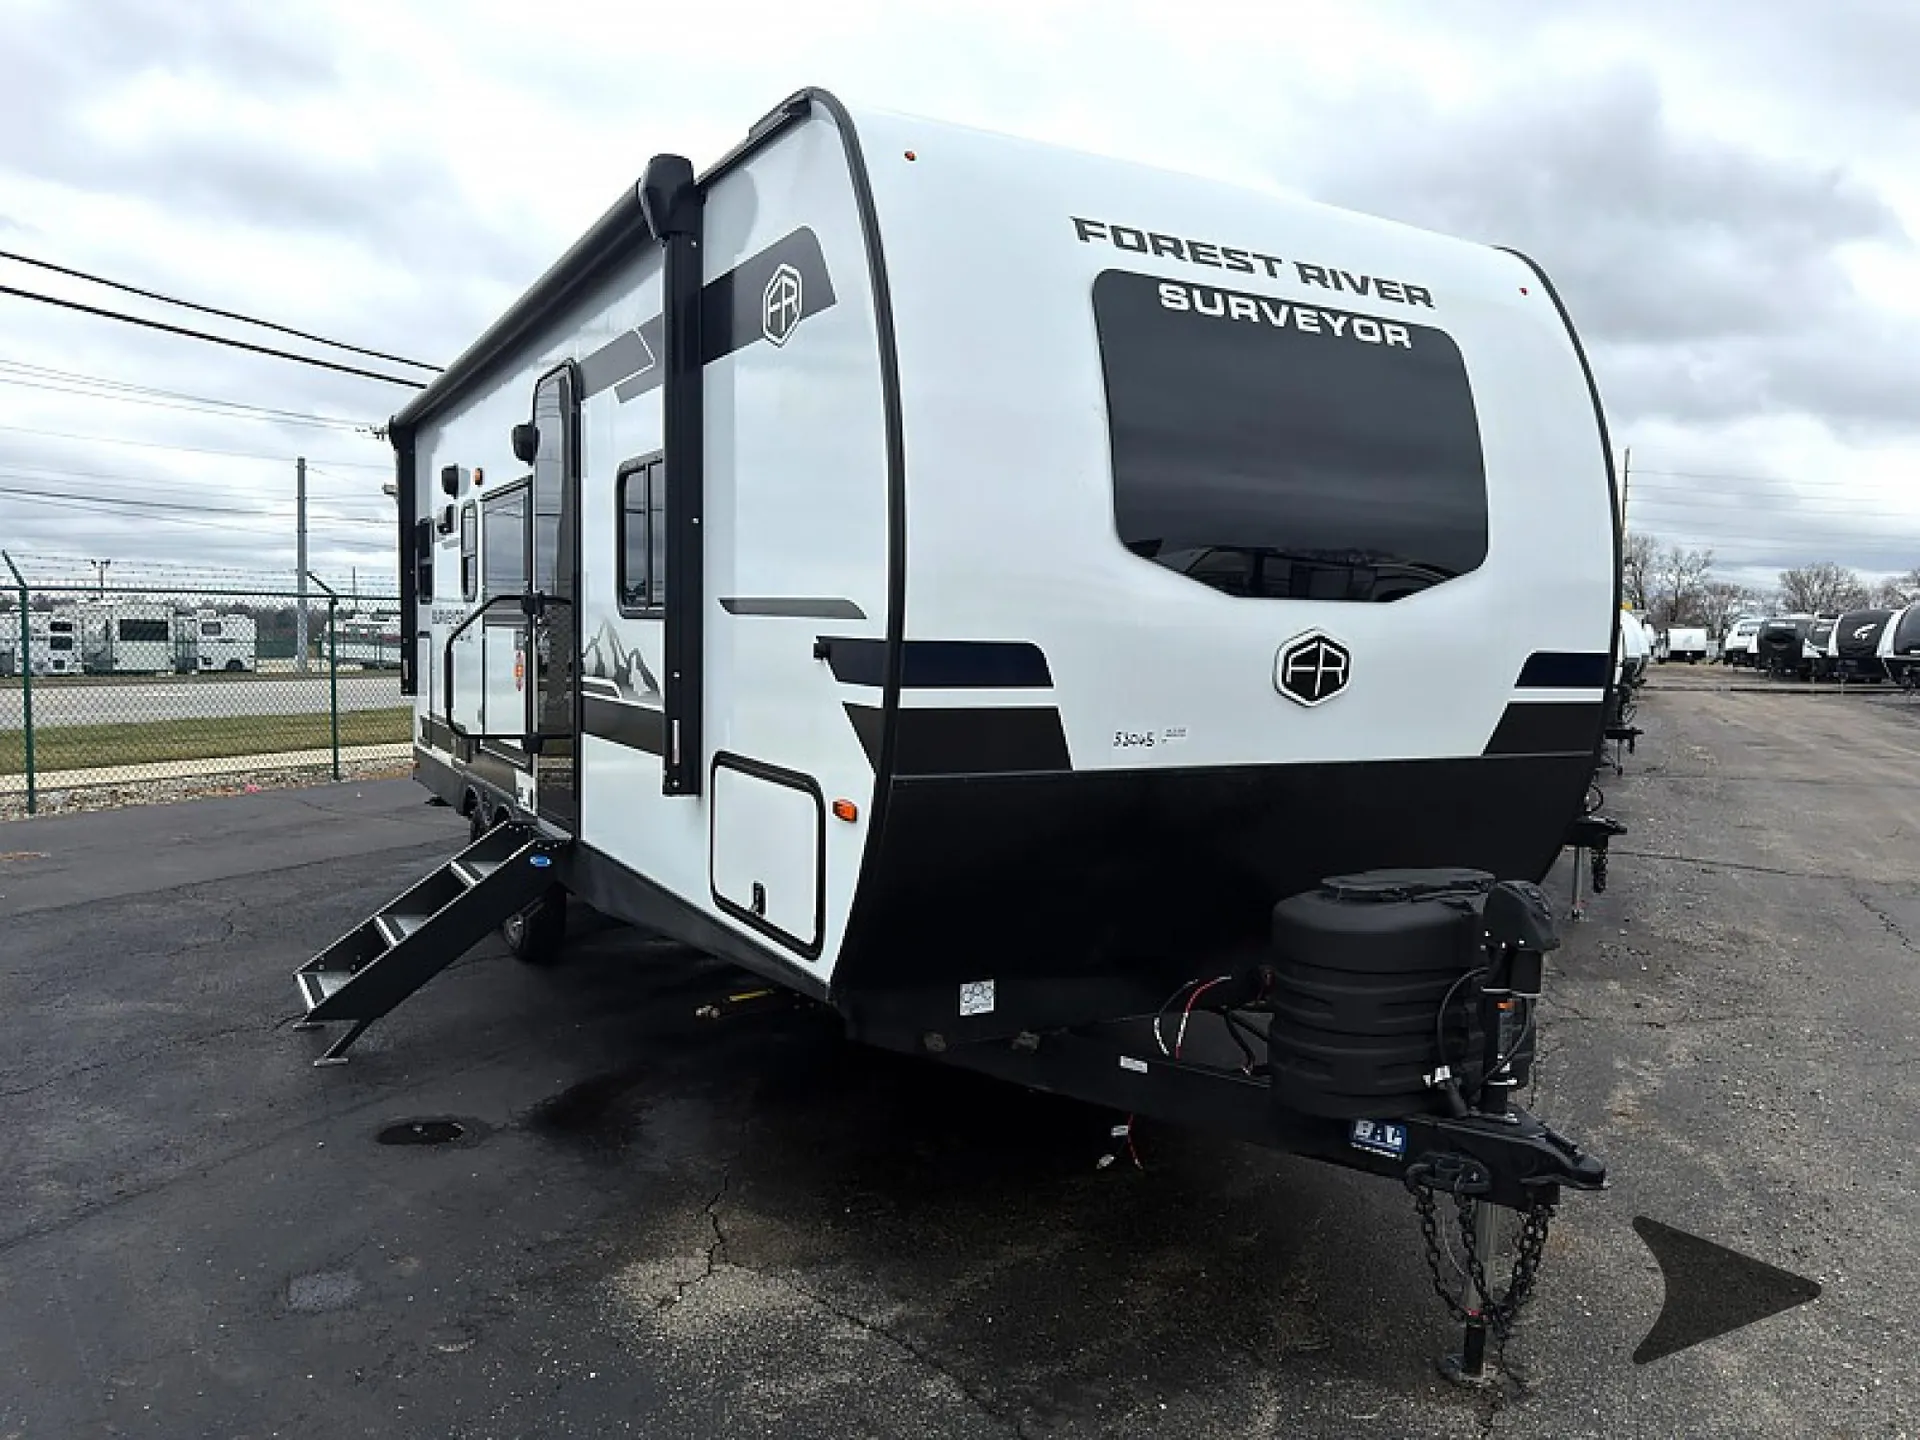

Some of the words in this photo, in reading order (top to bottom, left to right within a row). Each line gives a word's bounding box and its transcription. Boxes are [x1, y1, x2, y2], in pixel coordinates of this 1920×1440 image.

[1069, 215, 1282, 278] FOREST
[1293, 260, 1436, 310] RIVER
[1158, 282, 1413, 350] SURVEYOR
